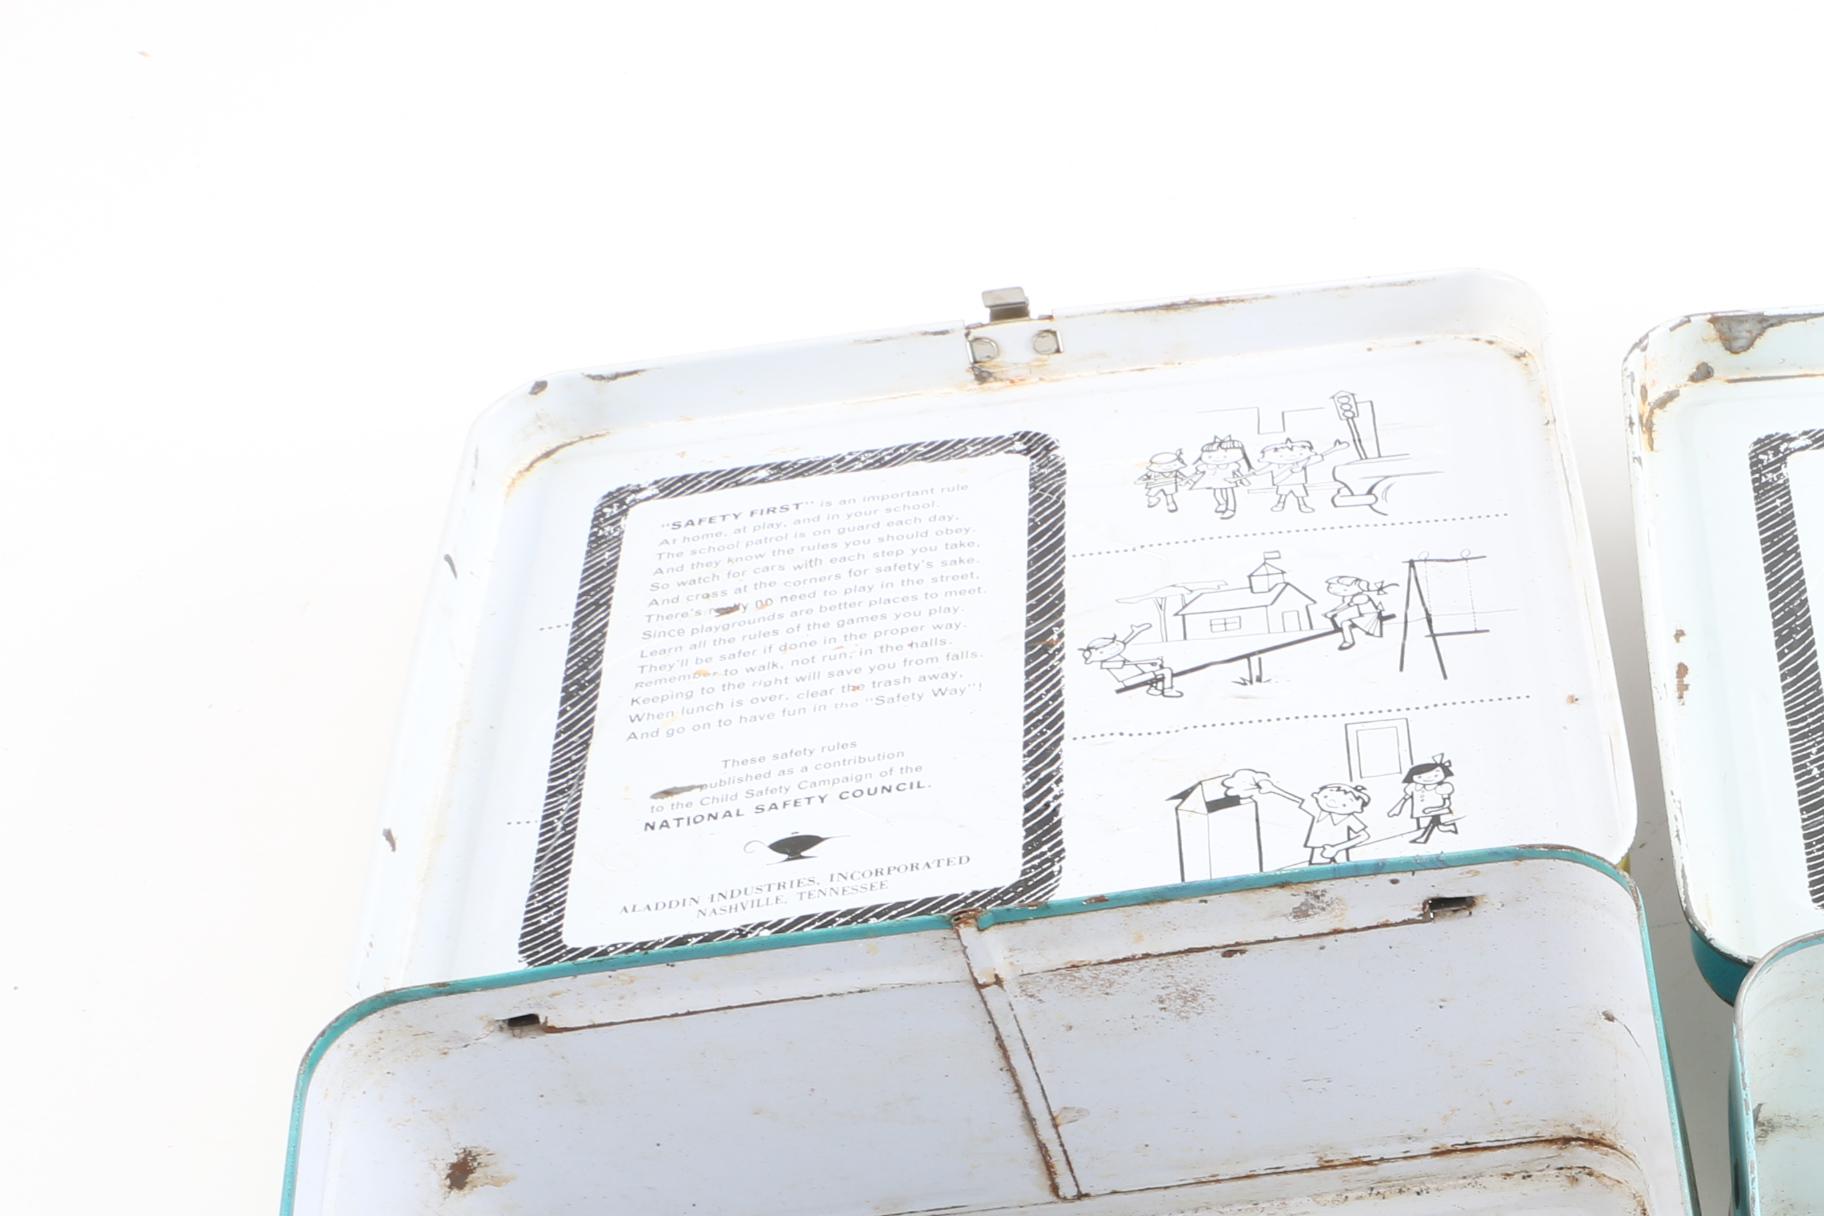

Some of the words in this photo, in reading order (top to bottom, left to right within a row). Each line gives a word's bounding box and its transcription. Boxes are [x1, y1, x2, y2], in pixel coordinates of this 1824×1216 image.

[838, 498, 856, 506] an
[862, 487, 934, 502] important
[940, 484, 969, 493] rule
[648, 594, 680, 608] And
[734, 584, 748, 595] at
[753, 580, 777, 591] the
[783, 573, 842, 587] corners
[848, 568, 868, 578] for
[649, 582, 670, 592] So
[676, 572, 720, 588] watch
[727, 570, 745, 579] for
[752, 564, 786, 574] cars
[792, 556, 823, 572] with
[829, 552, 866, 564] each
[872, 549, 905, 558] step
[911, 545, 938, 555] you
[639, 645, 683, 659] Learn
[688, 639, 706, 650] all
[712, 636, 736, 647] the
[742, 629, 780, 641] rules
[785, 623, 801, 634] of
[806, 621, 831, 632] the
[836, 613, 888, 629] games
[894, 610, 922, 620] you
[630, 690, 694, 707] Keeping
[700, 686, 716, 696] to
[721, 681, 746, 692] the
[752, 676, 789, 688] right
[795, 670, 821, 683] will
[827, 666, 862, 679] save
[868, 662, 896, 674] you
[902, 656, 939, 668] from
[626, 727, 660, 742] And
[665, 726, 686, 738] go
[691, 722, 712, 732] on
[718, 718, 733, 728] to
[739, 712, 776, 724] have
[781, 706, 807, 717] fun
[813, 704, 827, 713] in
[721, 755, 766, 769] These
[772, 747, 814, 761] safety
[820, 740, 857, 753] rules
[777, 767, 794, 777] as
[800, 765, 808, 774] a
[814, 751, 905, 770] contribution
[650, 804, 665, 814] to
[670, 801, 694, 811] the
[699, 791, 738, 807] Child
[744, 784, 791, 799] Safety
[797, 772, 873, 791] Campaign
[879, 766, 894, 778] of
[899, 764, 923, 775] the
[643, 807, 745, 832] NATIONAL
[753, 793, 829, 815] SAFETY
[620, 896, 700, 914] ALADDIN
[829, 855, 971, 883] INCORPORATED
[796, 879, 888, 902] TENNESSEE
